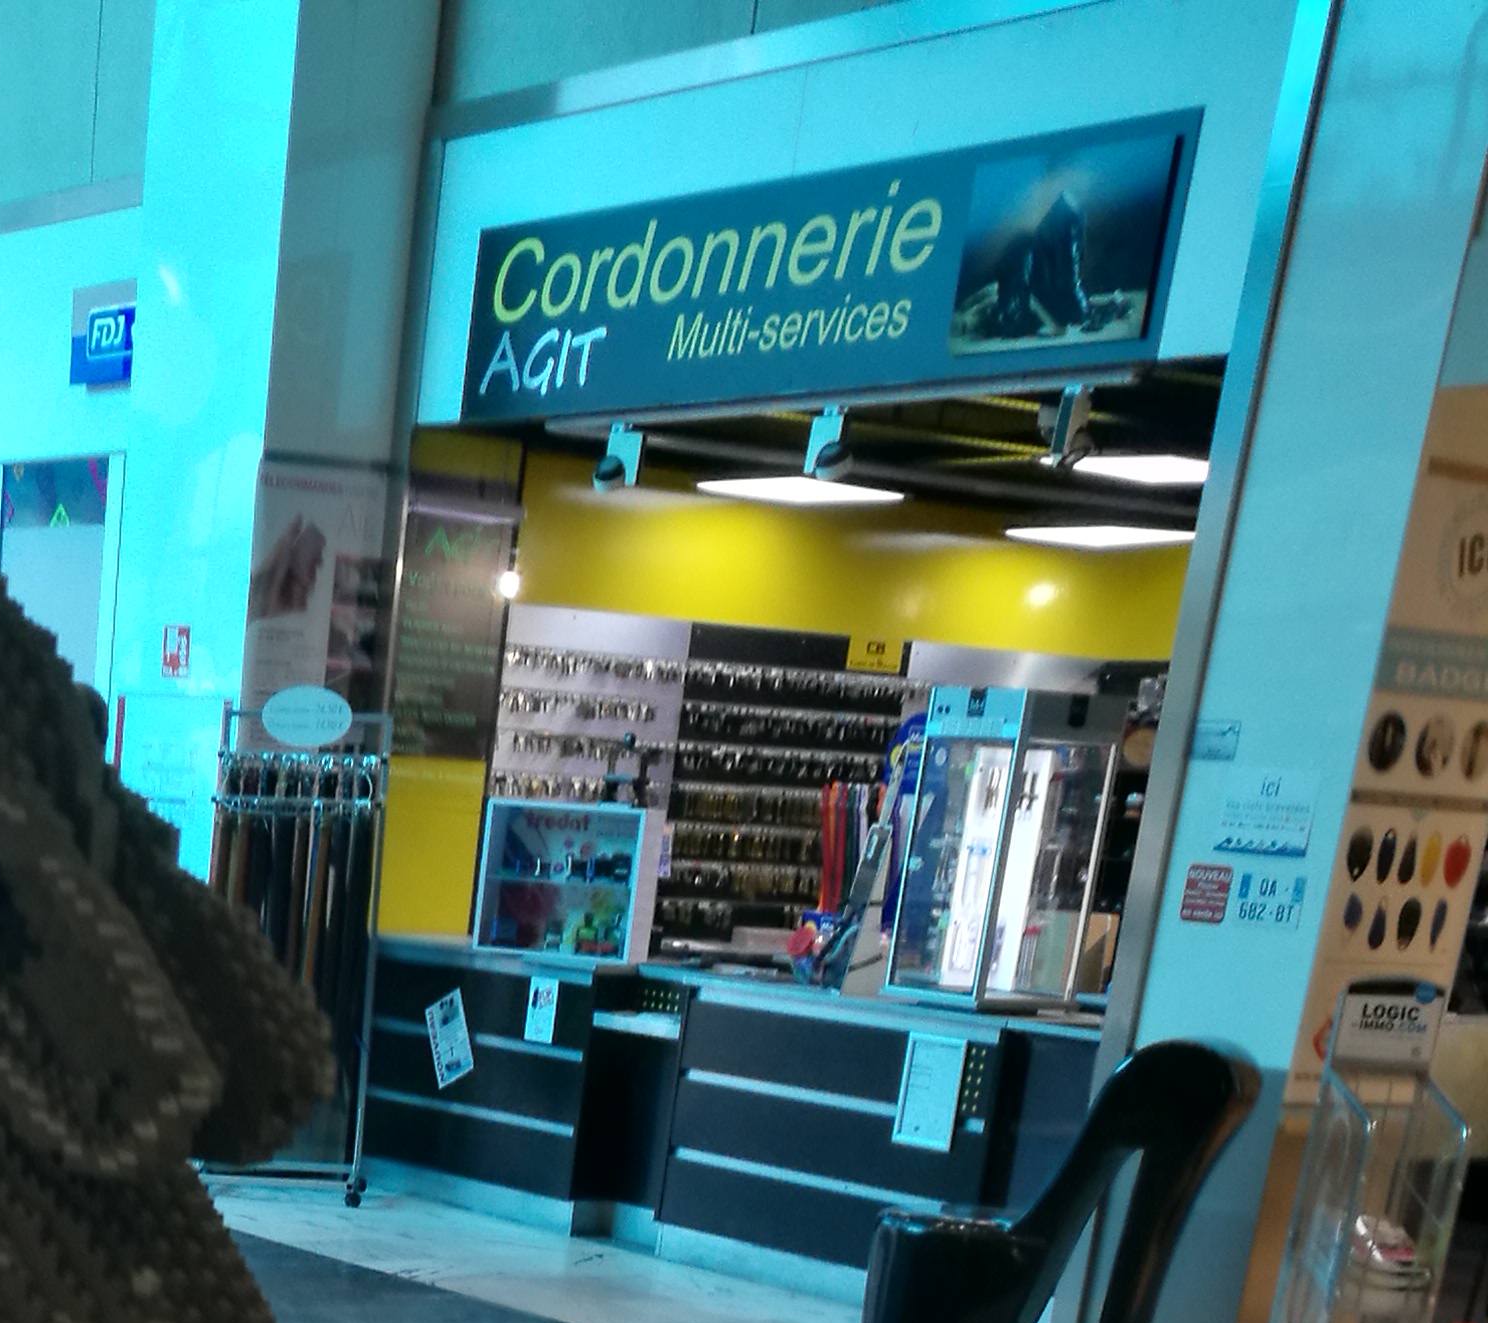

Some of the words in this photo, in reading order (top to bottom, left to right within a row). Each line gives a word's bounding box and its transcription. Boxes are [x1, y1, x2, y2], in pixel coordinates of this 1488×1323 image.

[494, 180, 943, 323] Cordonnerie
[92, 314, 126, 348] FDJ
[666, 294, 912, 362] Multi-services
[479, 326, 607, 397] AGIT
[1458, 533, 1488, 579] IC
[1260, 777, 1282, 797] ici
[1362, 1002, 1421, 1021] LOGIC
